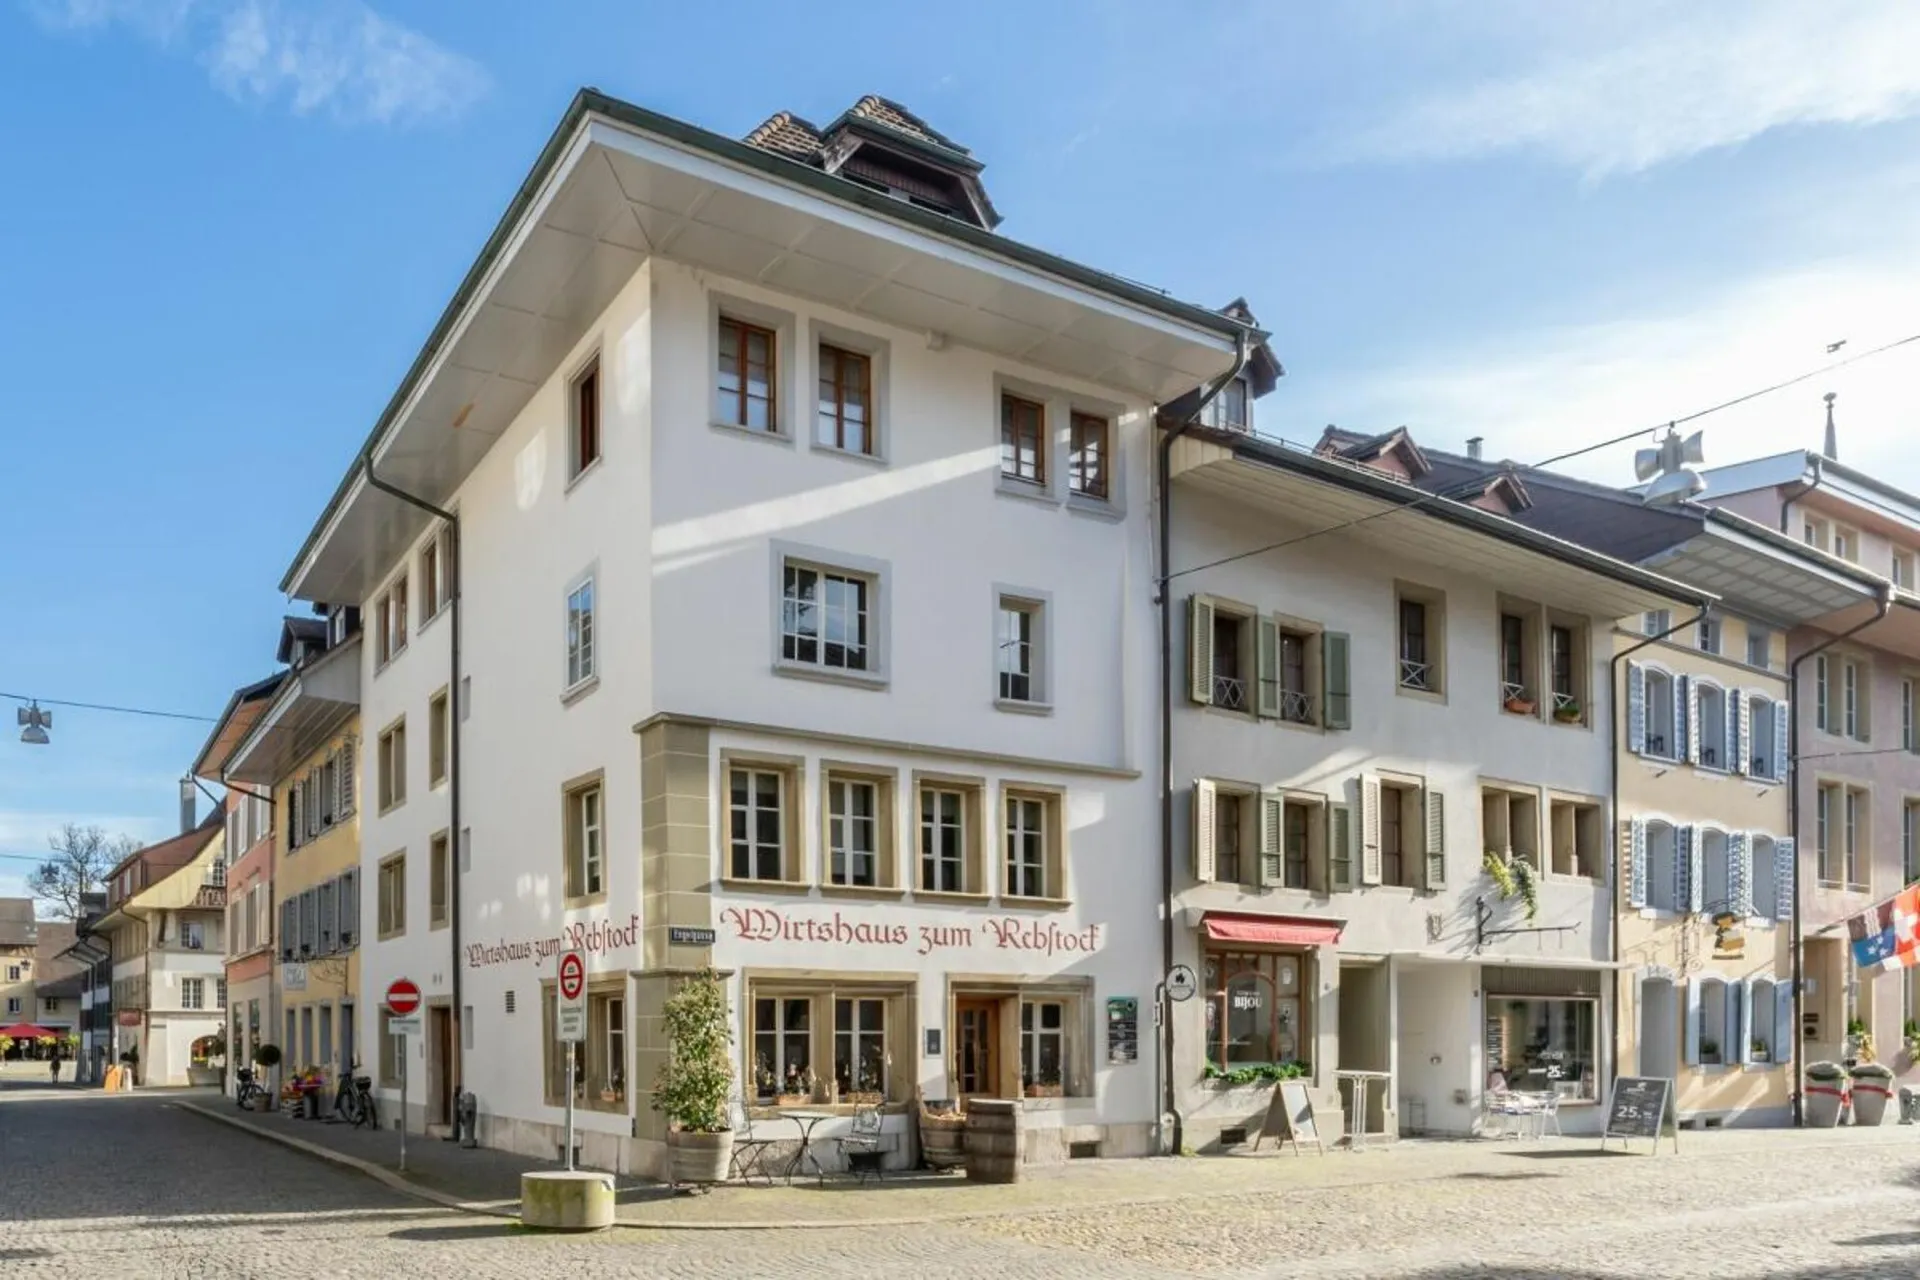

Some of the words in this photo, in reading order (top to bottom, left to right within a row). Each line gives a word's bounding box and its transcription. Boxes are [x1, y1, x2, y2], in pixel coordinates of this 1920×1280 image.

[720, 907, 908, 944] Wirtshaus
[917, 926, 972, 955] zum
[465, 938, 531, 968] Wirtshaus
[534, 937, 561, 967] zum
